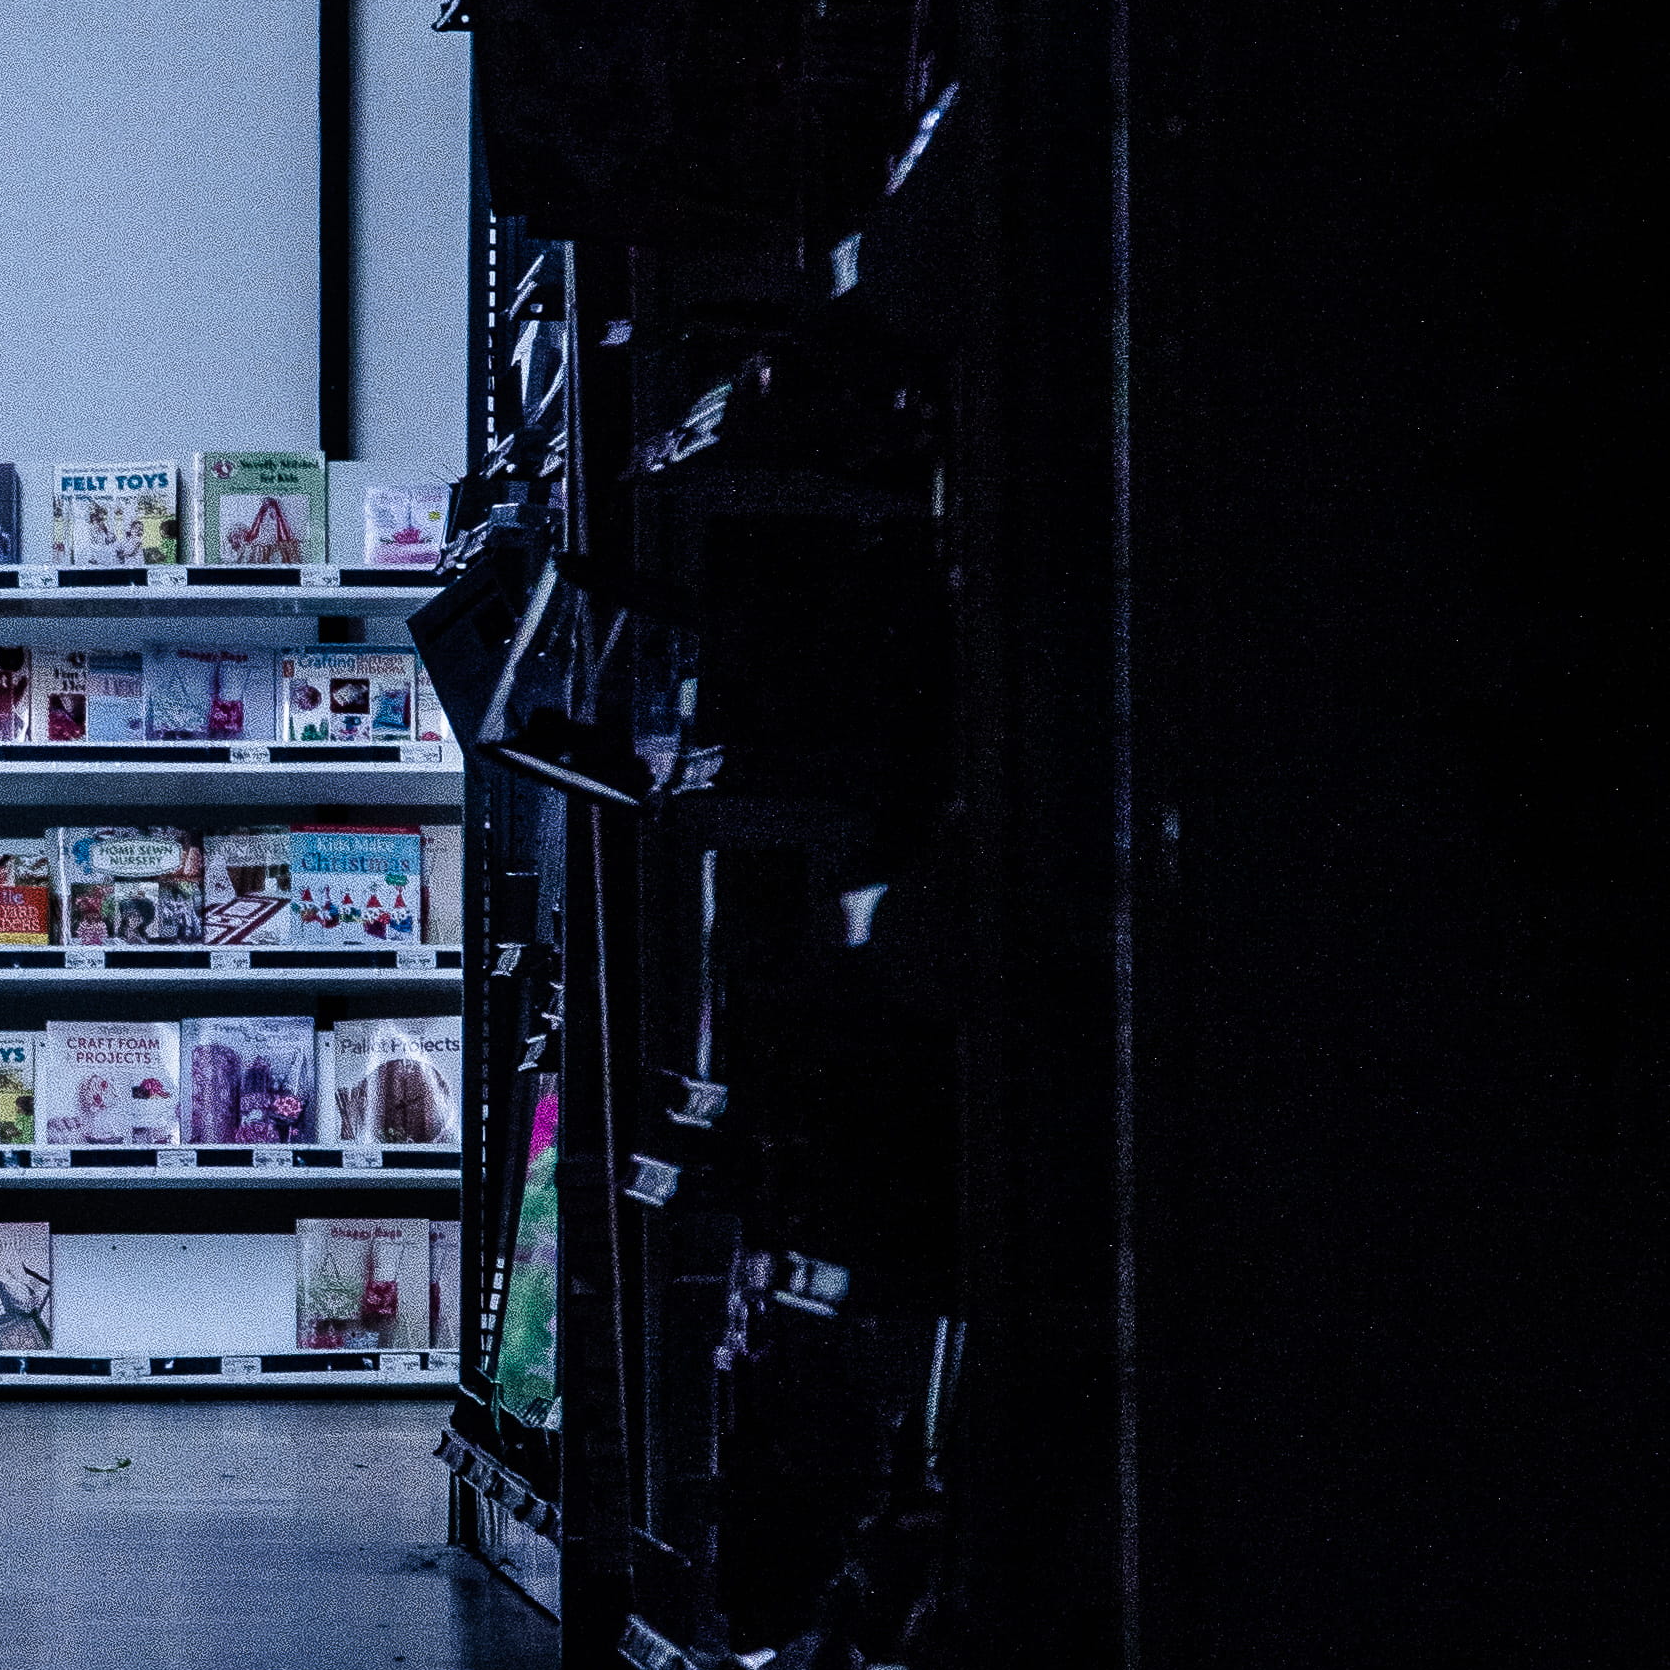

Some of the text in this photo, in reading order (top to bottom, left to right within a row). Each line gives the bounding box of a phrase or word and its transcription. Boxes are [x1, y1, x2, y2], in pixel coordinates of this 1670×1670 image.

[61, 472, 169, 492] FELT TOYS
[298, 653, 356, 672] Crafting
[100, 845, 173, 856] HOME SEWN
[110, 856, 163, 867] NURSERY
[301, 851, 411, 873] Christmas
[67, 1036, 160, 1050] CRAFT FOAM
[76, 1051, 152, 1064] PROJECTS
